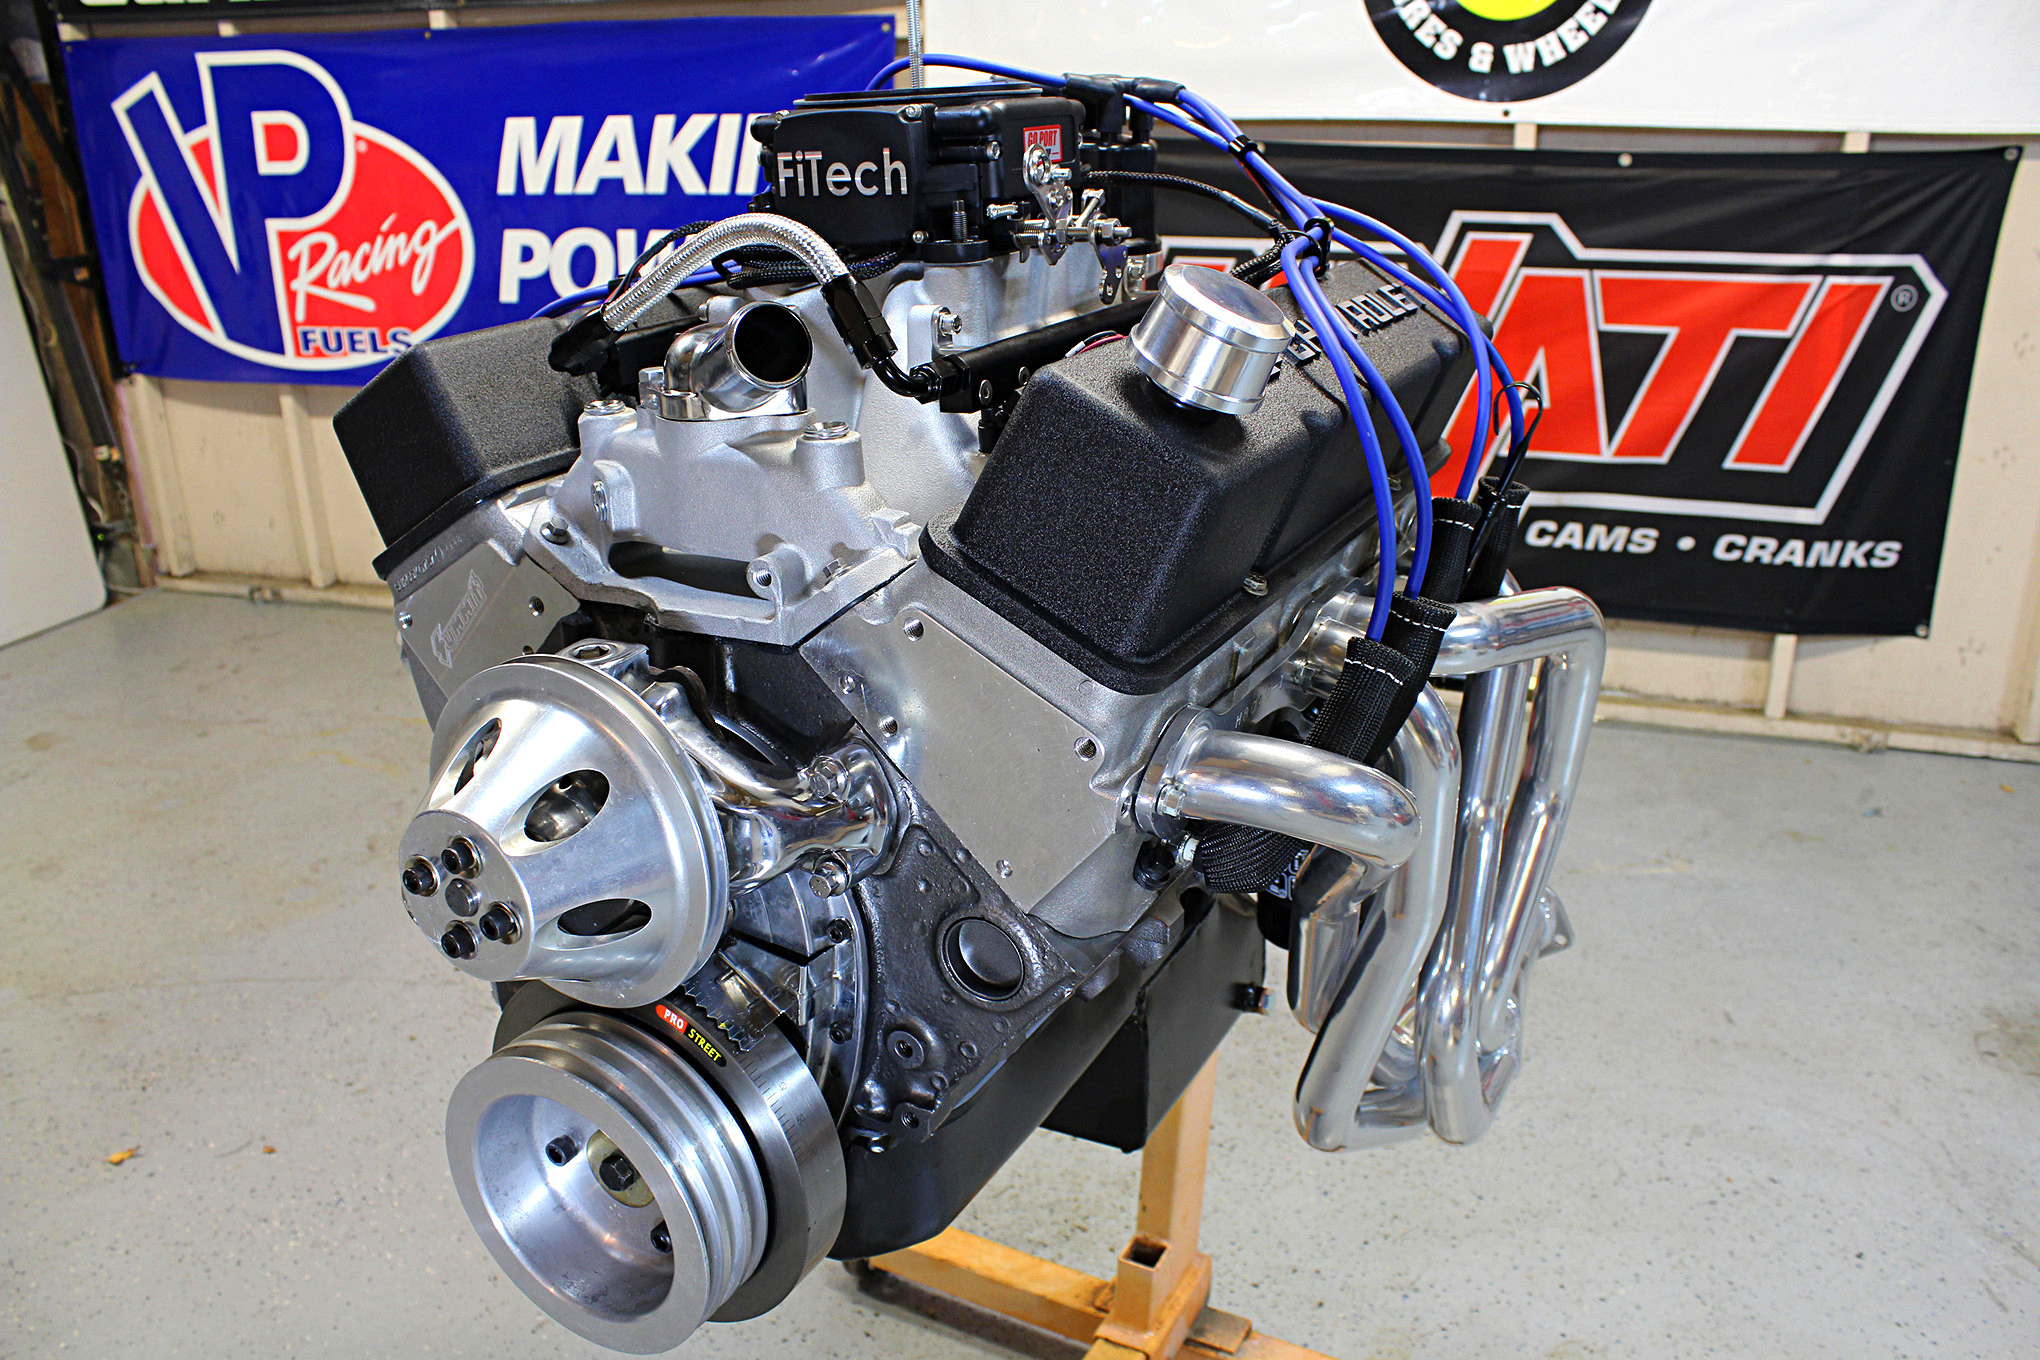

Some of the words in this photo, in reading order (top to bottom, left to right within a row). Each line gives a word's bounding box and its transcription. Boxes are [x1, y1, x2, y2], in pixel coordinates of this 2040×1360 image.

[1392, 0, 1463, 60] RES
[1468, 41, 1495, 74] &
[1039, 129, 1058, 147] PORT
[777, 147, 908, 197] FiTech
[111, 50, 353, 358] VP
[288, 212, 462, 324] Racing
[296, 326, 414, 356] FUELS
[1525, 520, 1660, 554] CAMS
[1712, 533, 1903, 568] CRANKS
[664, 1008, 685, 1030] PRO
[687, 1028, 722, 1062] STREET
